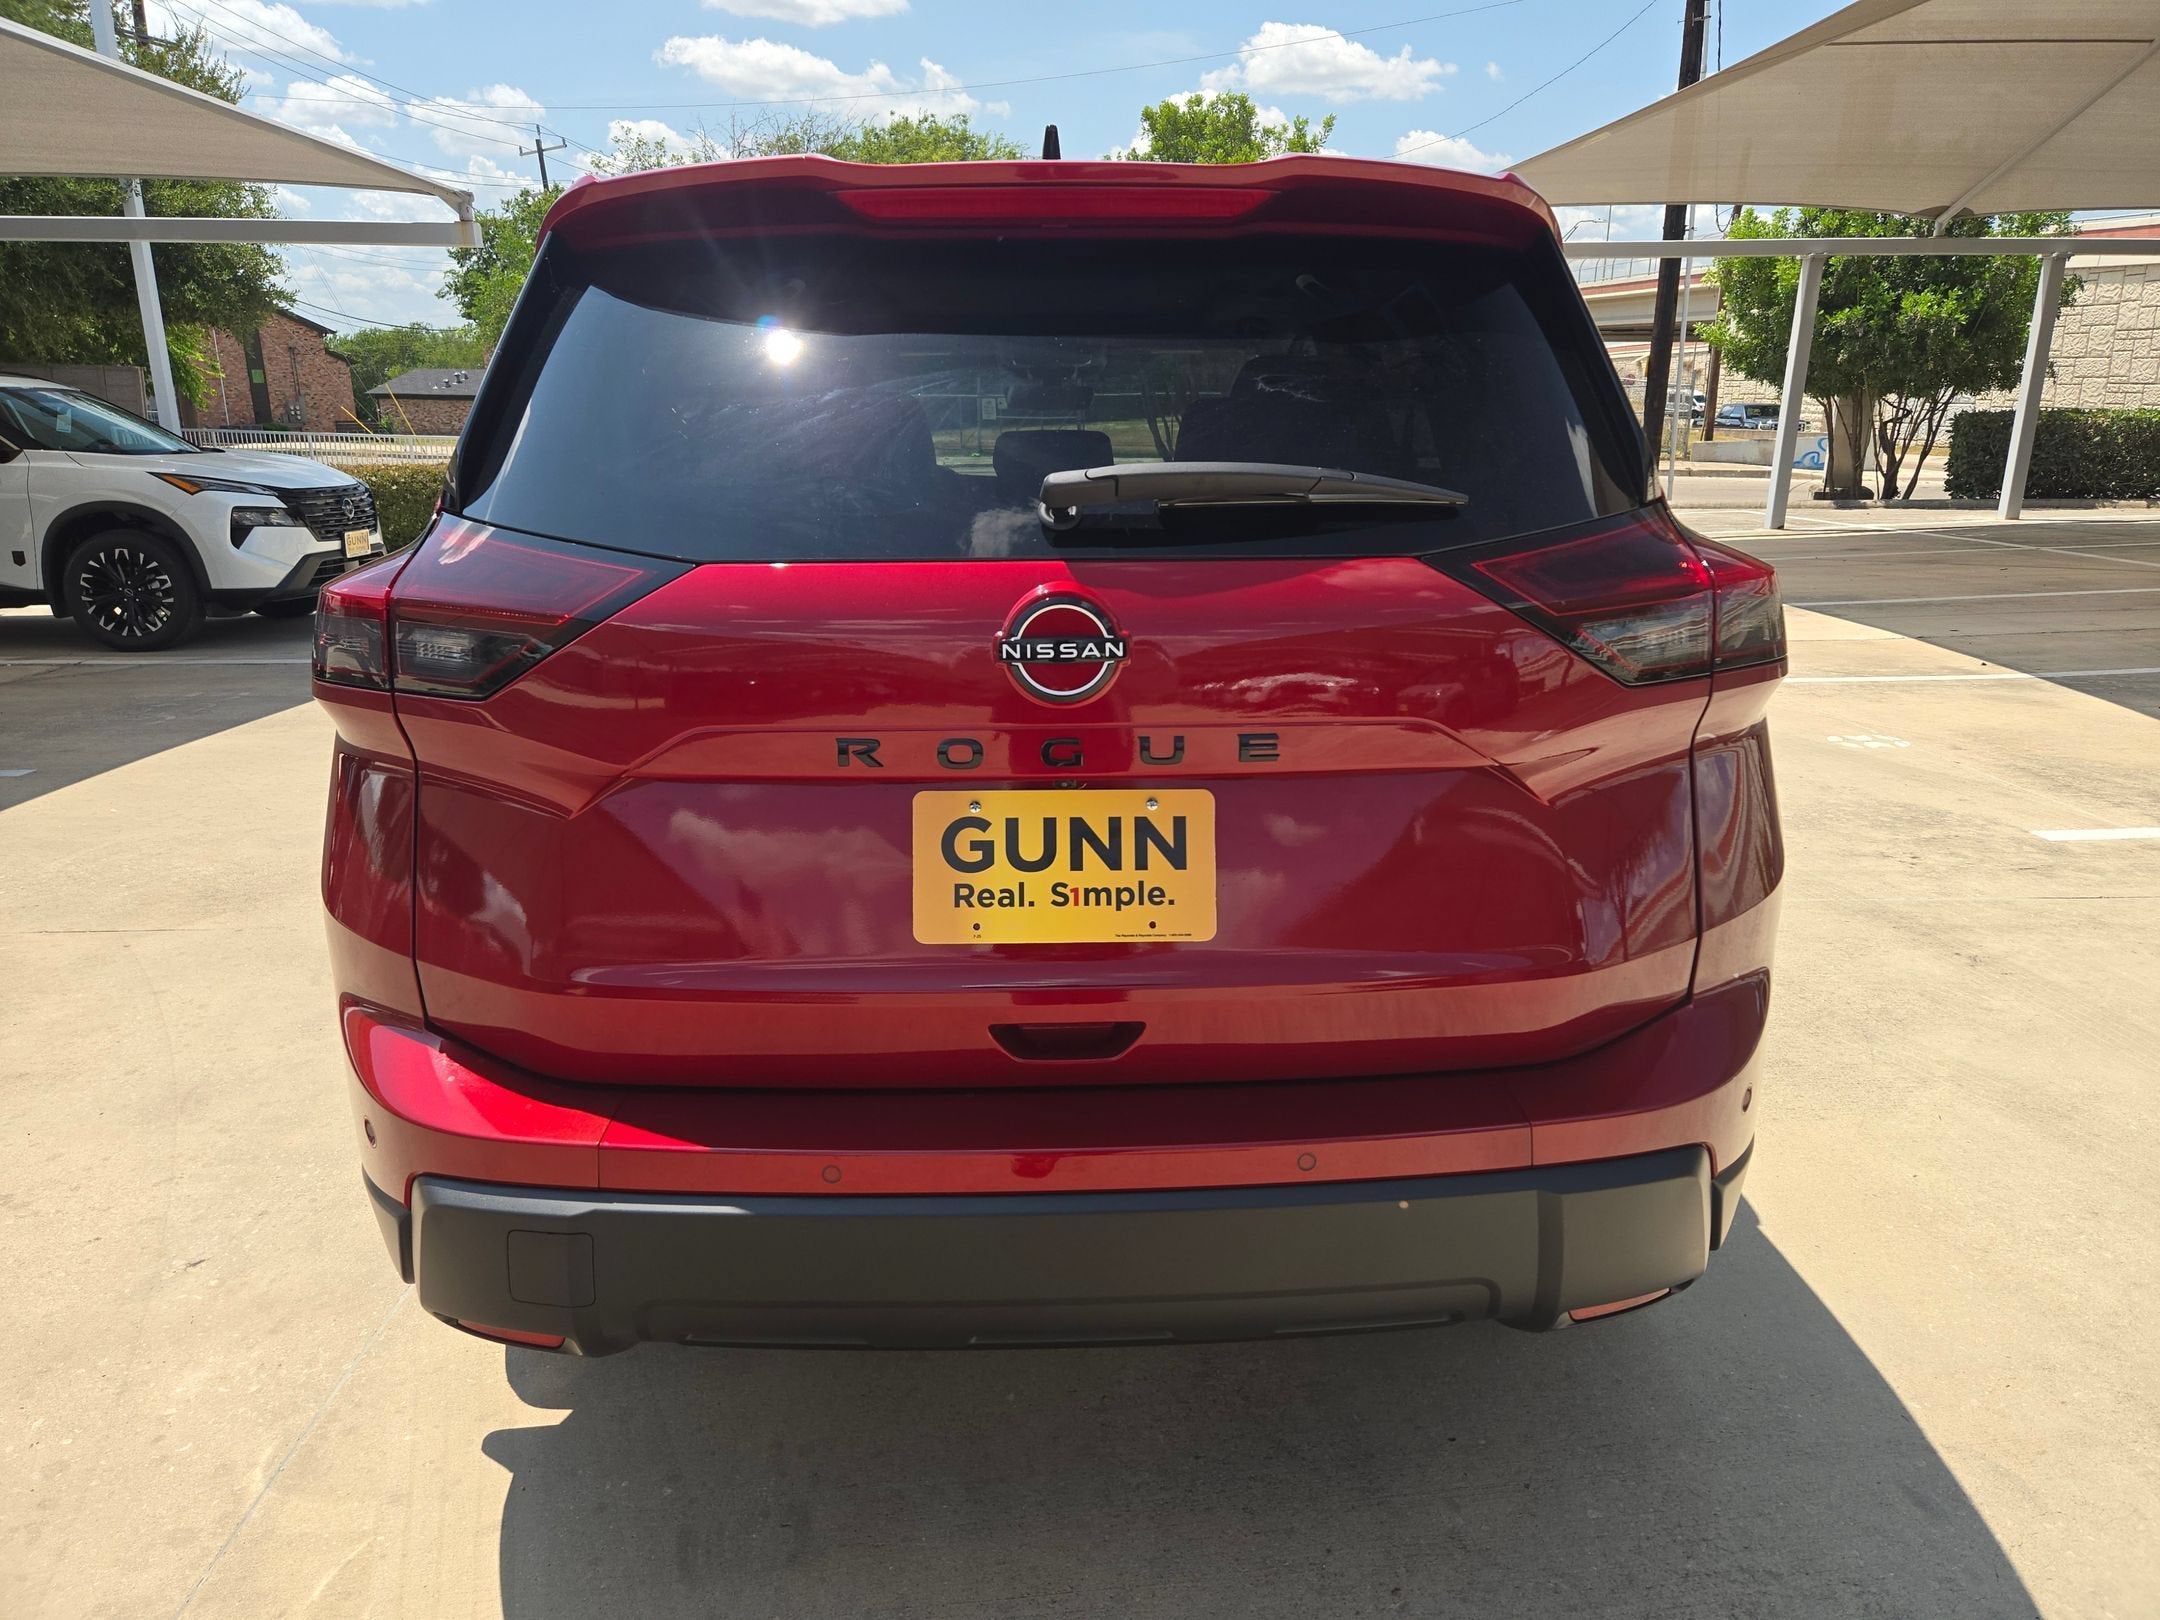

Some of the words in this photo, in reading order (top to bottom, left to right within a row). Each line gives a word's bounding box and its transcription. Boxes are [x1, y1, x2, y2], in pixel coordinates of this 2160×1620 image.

[347, 535, 368, 545] GUNN
[1002, 641, 1124, 659] NISSAN
[835, 733, 1281, 769] ROGUE
[940, 816, 1187, 873] GUNN
[953, 882, 1035, 908] Real.
[1051, 880, 1175, 911] S1mple.
